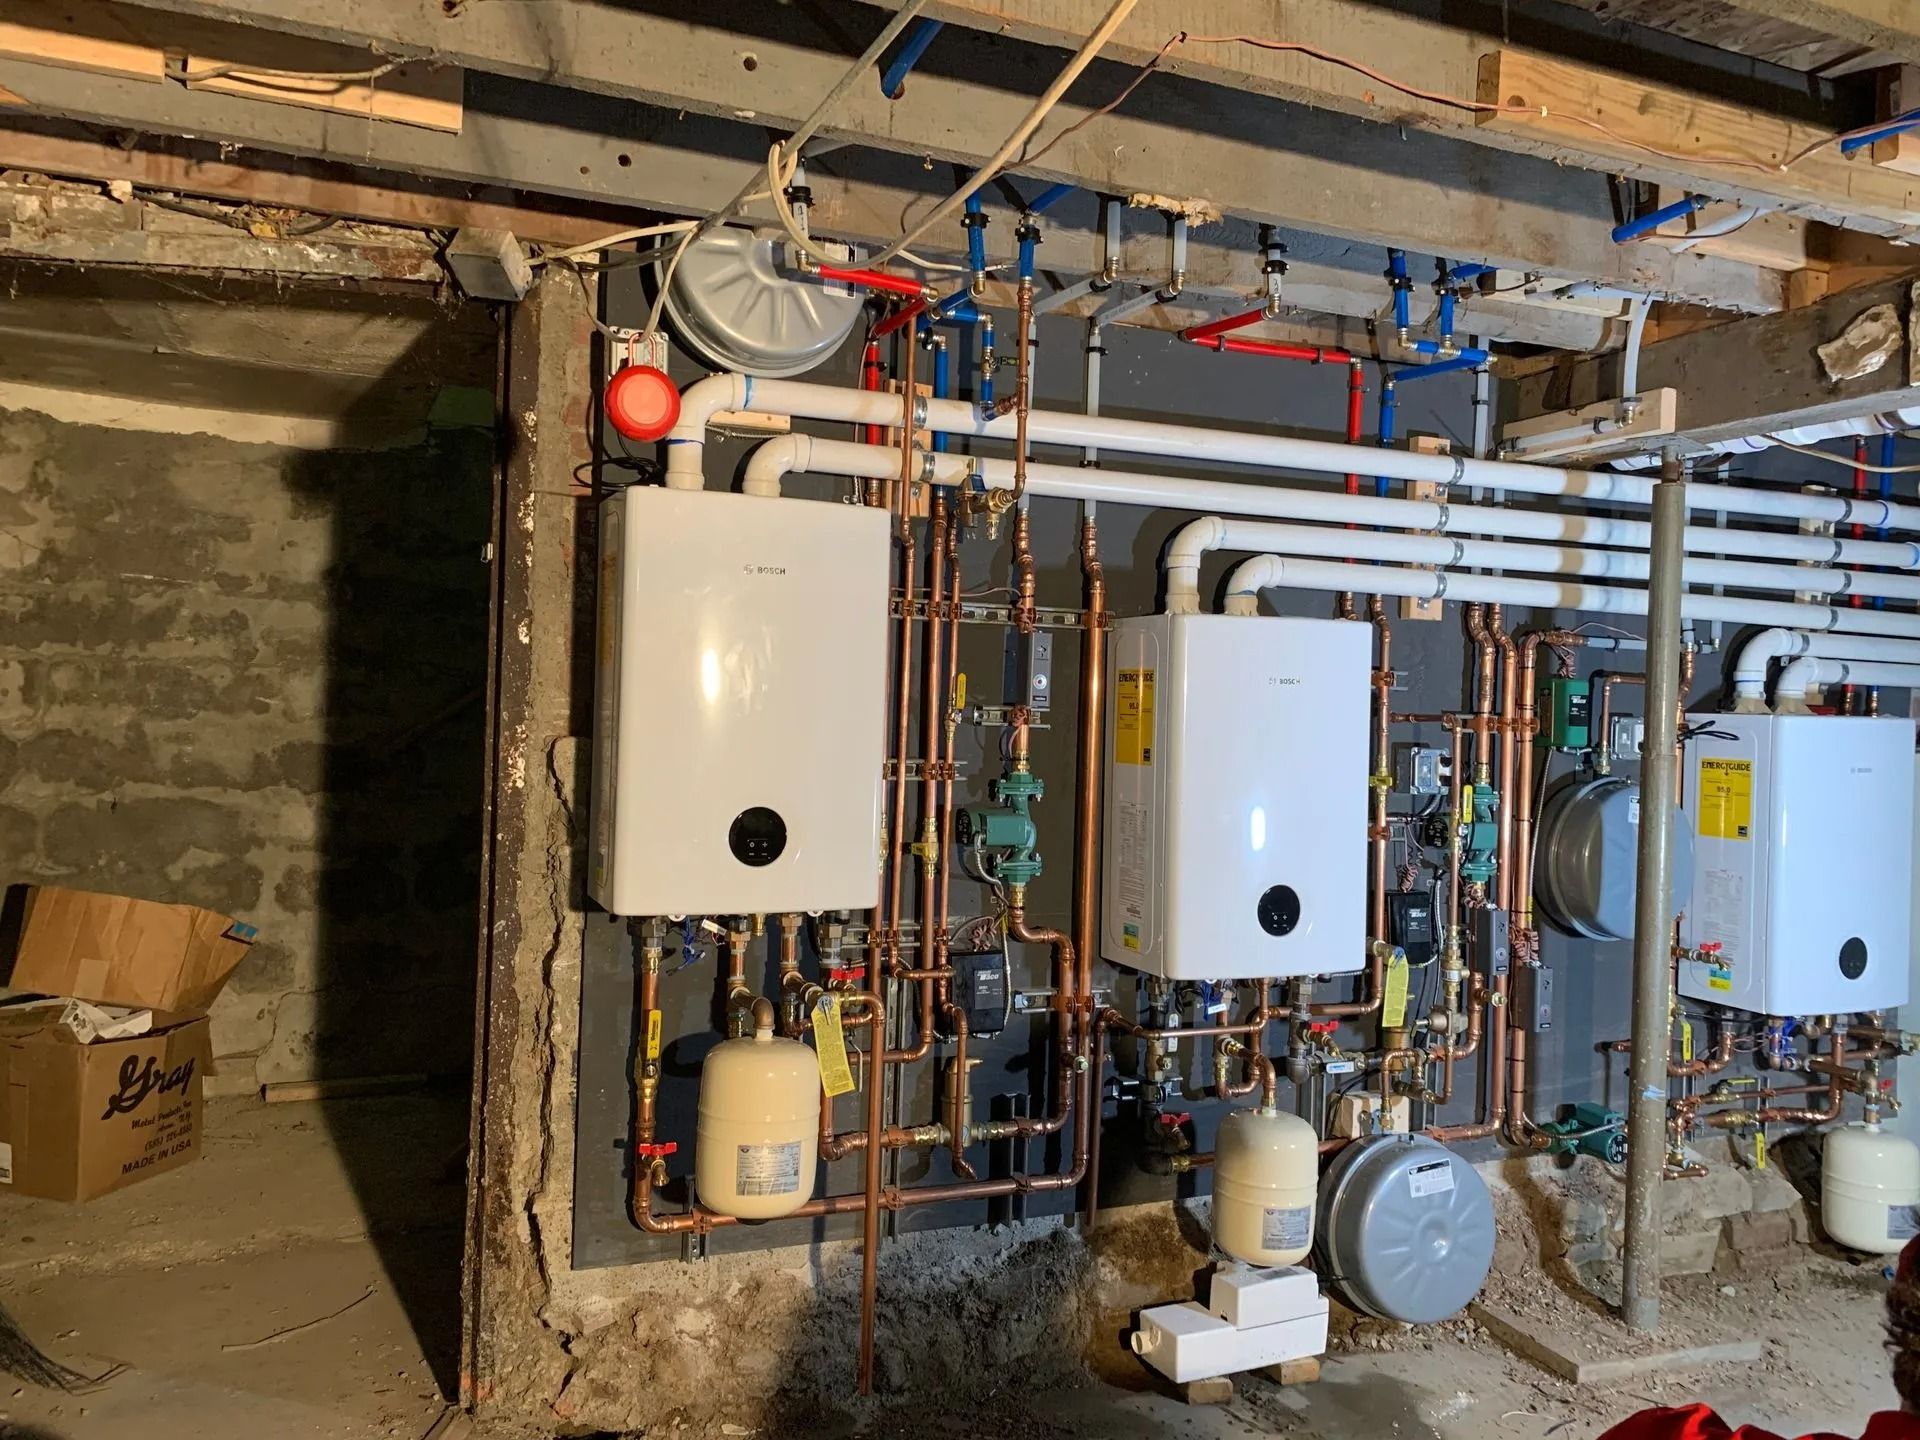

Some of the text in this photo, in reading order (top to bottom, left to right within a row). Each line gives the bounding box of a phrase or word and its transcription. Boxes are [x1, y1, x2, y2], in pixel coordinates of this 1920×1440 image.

[757, 566, 786, 575] BOSCH
[101, 1055, 196, 1120] Gray
[121, 1138, 192, 1175] MADE IN USA
